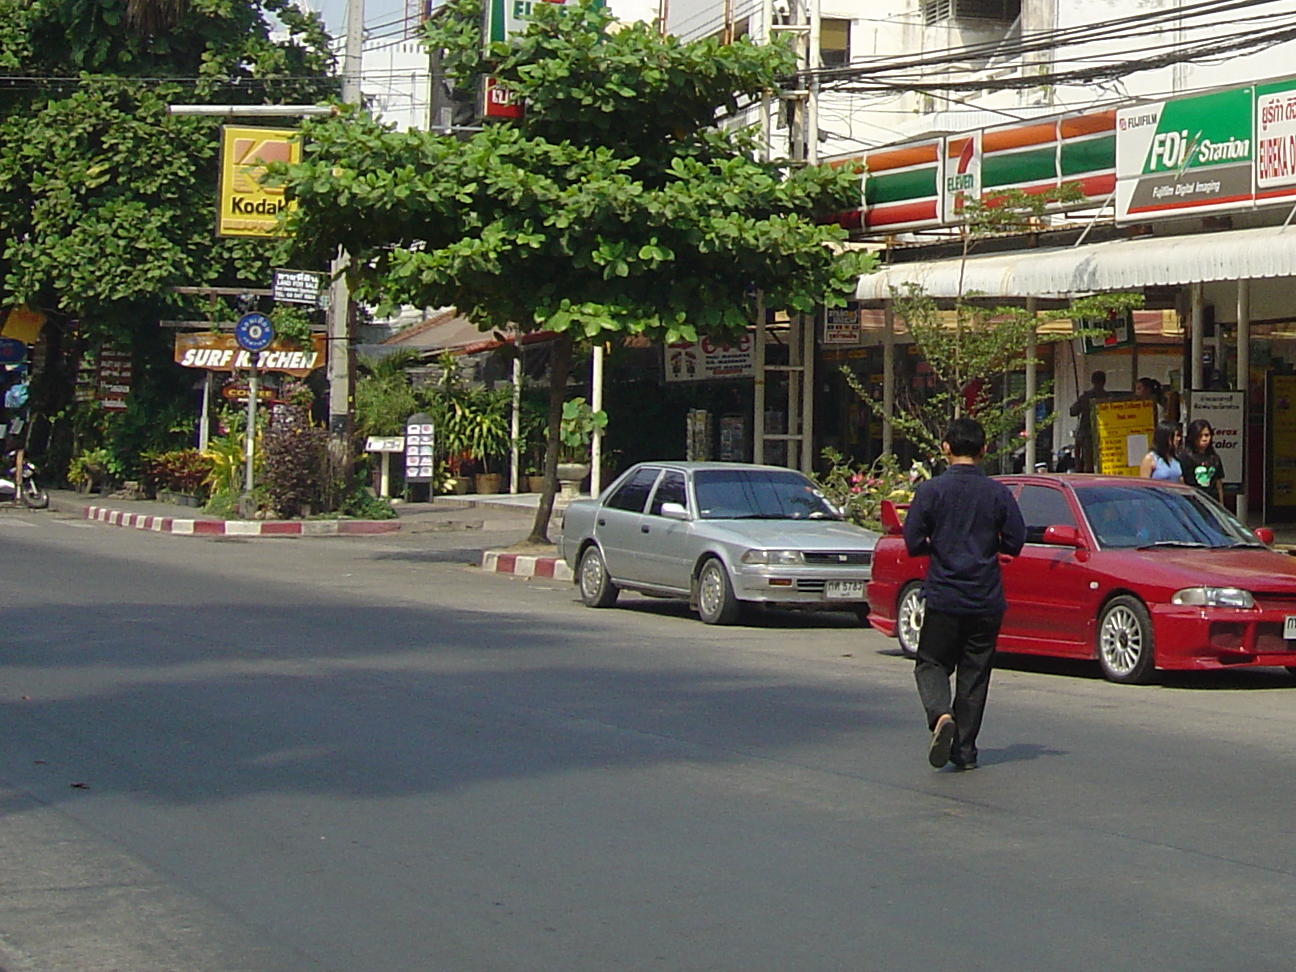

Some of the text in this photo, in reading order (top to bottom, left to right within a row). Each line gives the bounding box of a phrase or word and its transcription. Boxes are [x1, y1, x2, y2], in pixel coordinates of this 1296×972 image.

[1128, 113, 1157, 129] FUJIFILM
[1260, 136, 1288, 179] EUREKA
[947, 173, 974, 192] ELEVEN
[181, 349, 318, 369] SURF KTCHEN
